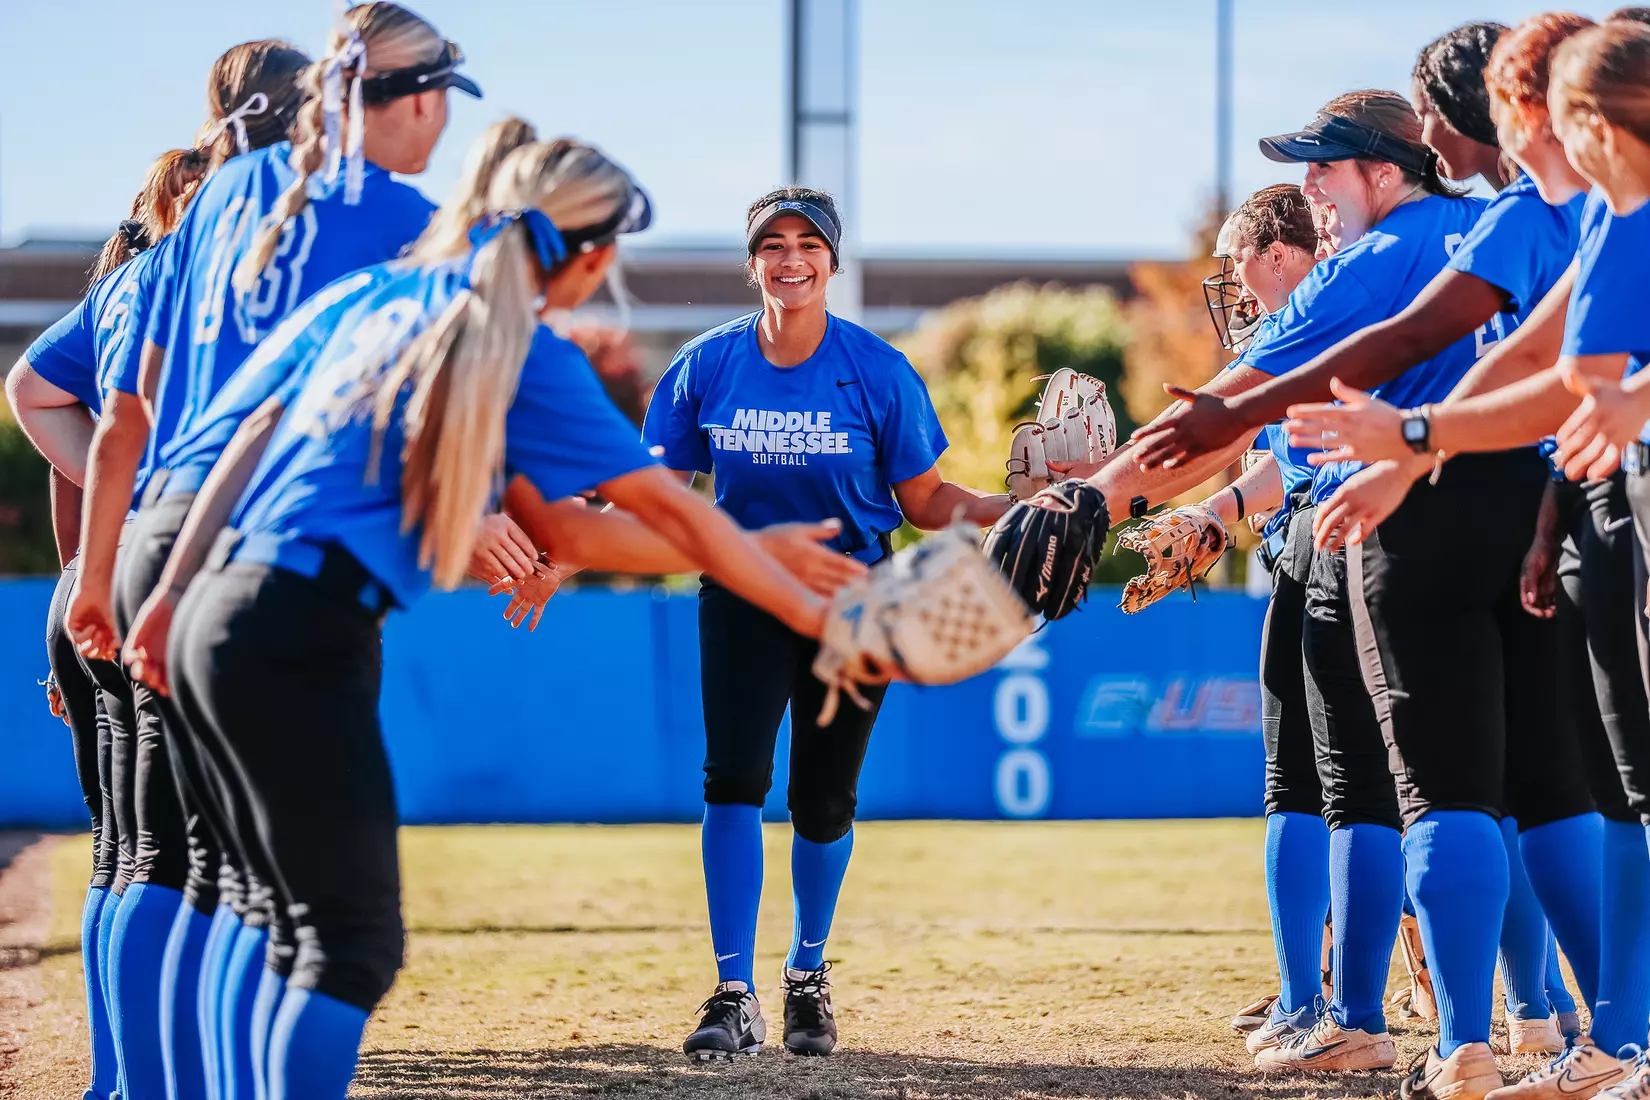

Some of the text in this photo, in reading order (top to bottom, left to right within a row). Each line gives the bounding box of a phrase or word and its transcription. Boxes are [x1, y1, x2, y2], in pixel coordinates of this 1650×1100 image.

[731, 408, 832, 433] MIDDLE
[711, 428, 849, 455] TENNESSEE
[1097, 424, 1108, 460] EAST
[752, 453, 808, 466] SOFTBALL
